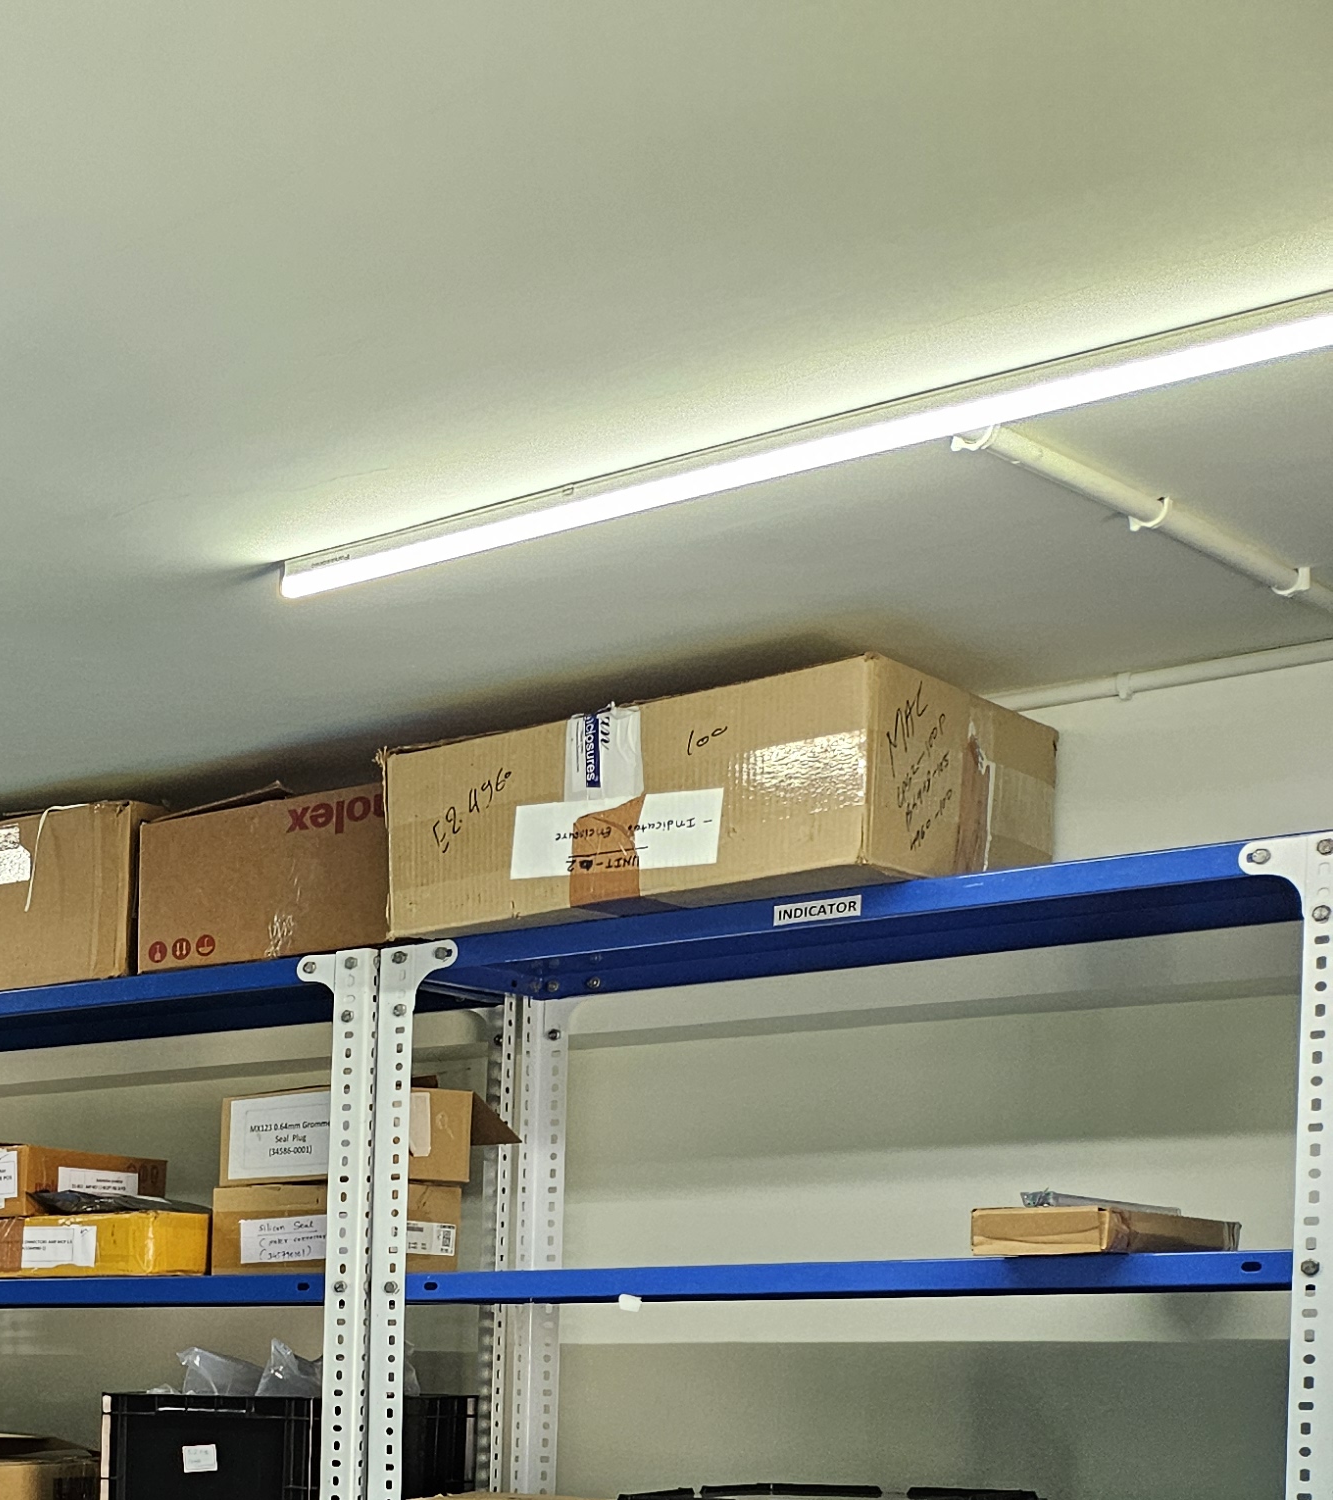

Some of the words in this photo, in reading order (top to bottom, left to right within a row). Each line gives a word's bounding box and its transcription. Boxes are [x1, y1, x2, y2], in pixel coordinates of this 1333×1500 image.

[585, 715, 599, 781] nclosures
[778, 900, 857, 921] INDICATOR
[274, 1121, 301, 1132] 0.64mm
[302, 1119, 330, 1129] Gromme
[275, 1134, 290, 1144] Seal
[292, 1134, 307, 1144] Plug
